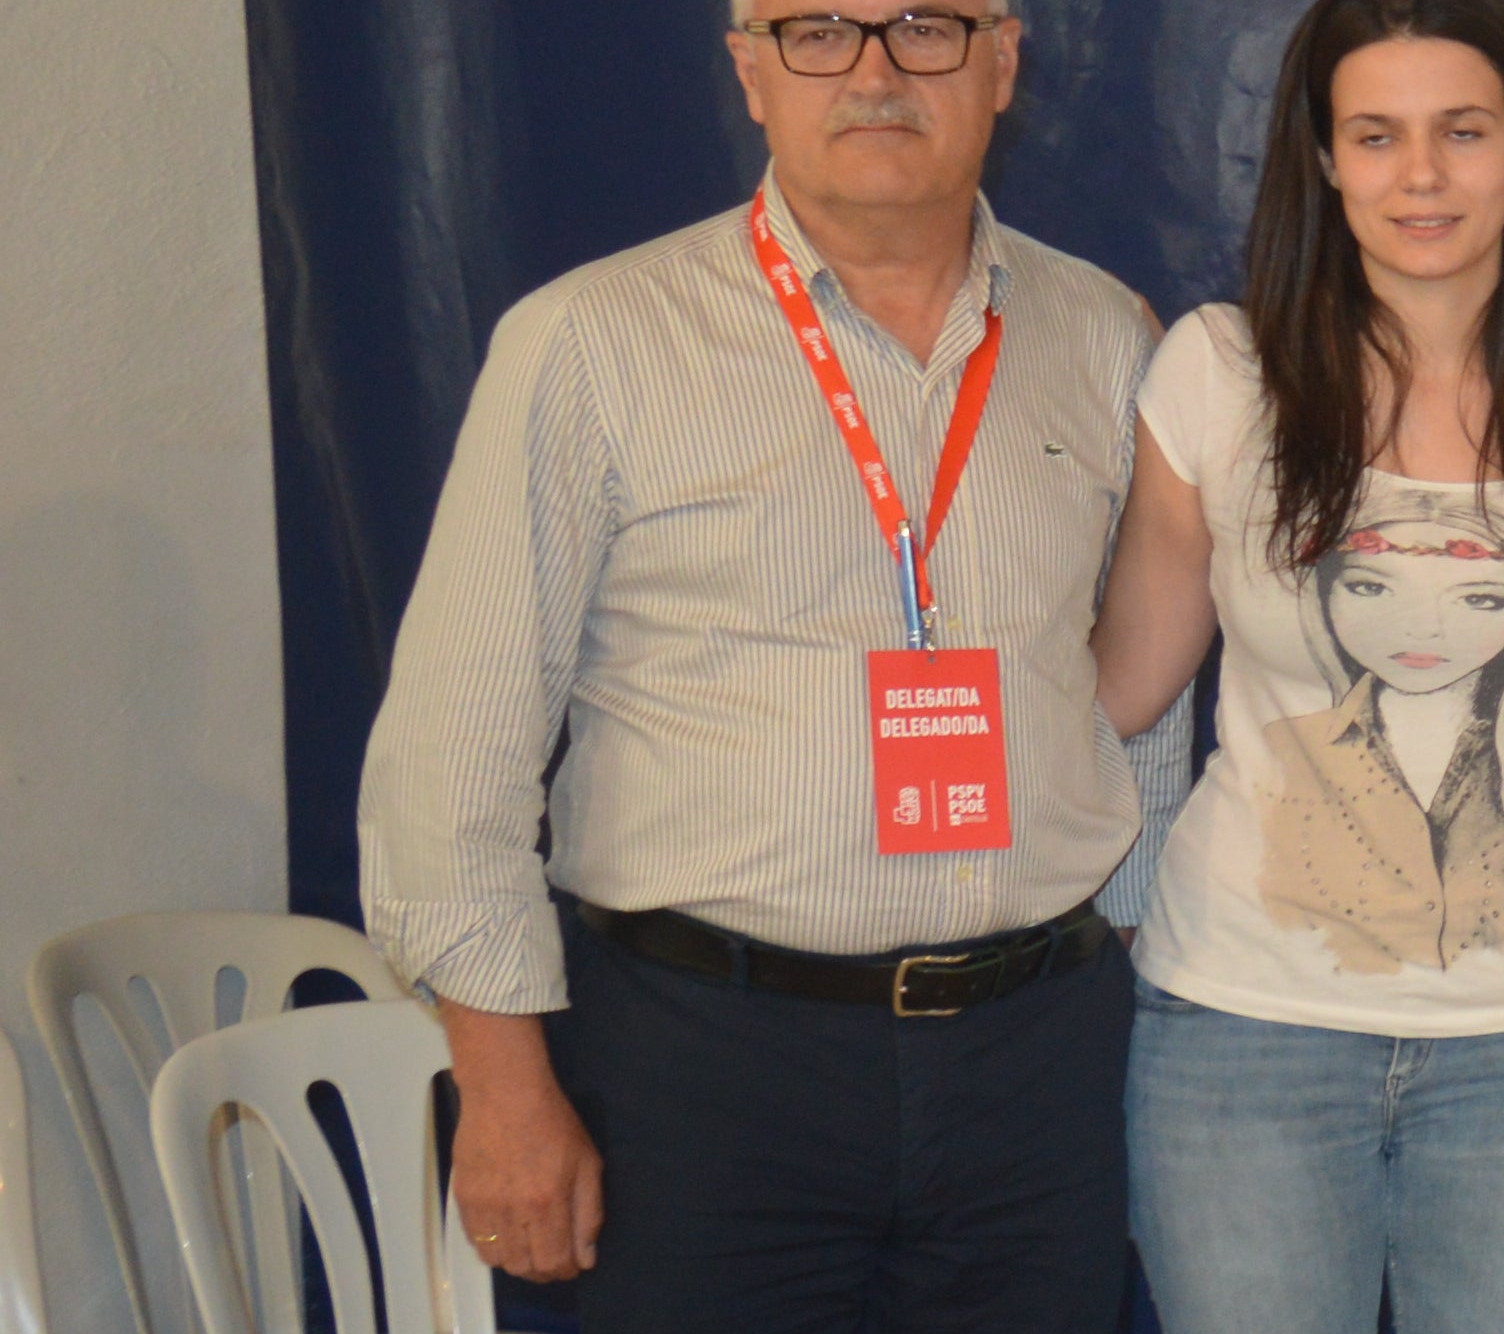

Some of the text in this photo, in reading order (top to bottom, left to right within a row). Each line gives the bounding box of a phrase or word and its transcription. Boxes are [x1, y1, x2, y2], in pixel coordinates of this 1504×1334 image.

[885, 687, 980, 709] DELEGAT/DA
[880, 716, 990, 738] DELEGADO/DA
[948, 784, 985, 799] PSPV
[949, 799, 986, 814] PSOE
